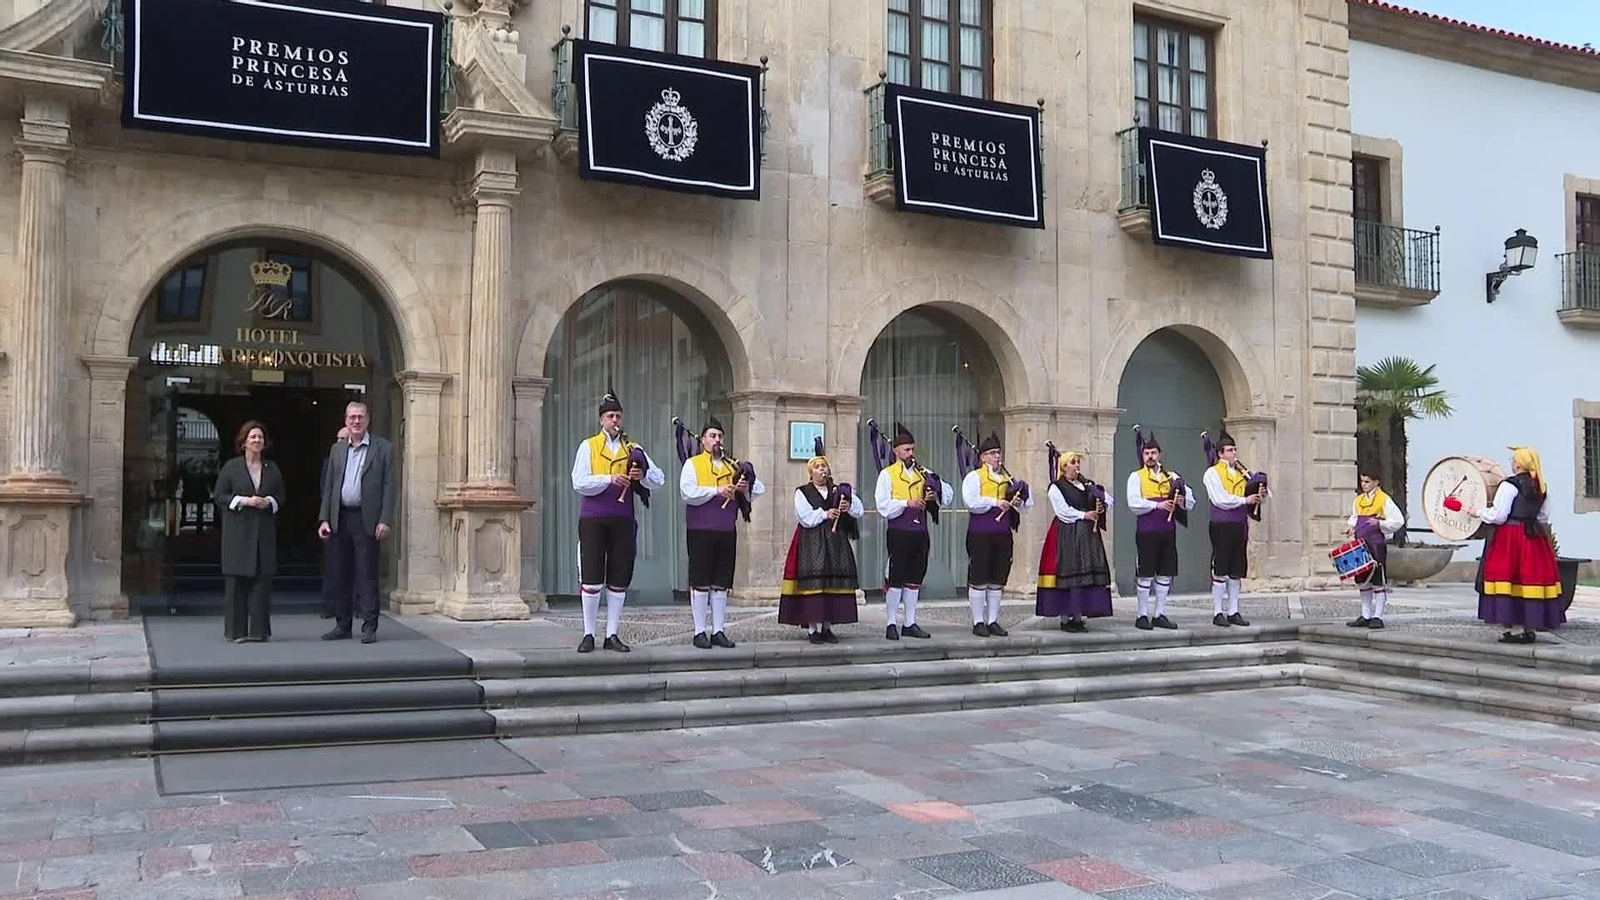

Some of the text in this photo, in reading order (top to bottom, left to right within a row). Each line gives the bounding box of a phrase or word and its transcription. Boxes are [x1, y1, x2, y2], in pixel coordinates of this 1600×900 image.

[232, 36, 349, 65] PREMIOS
[232, 55, 348, 82] PRINCESA
[232, 73, 349, 97] DE ASTURIAS
[931, 131, 1006, 155] PREMIOS
[933, 147, 1007, 170] PRINCESA
[934, 162, 1009, 181] DE ASTURIAS
[236, 327, 304, 345] HOTEL
[231, 348, 367, 369] RECONQUISTA
